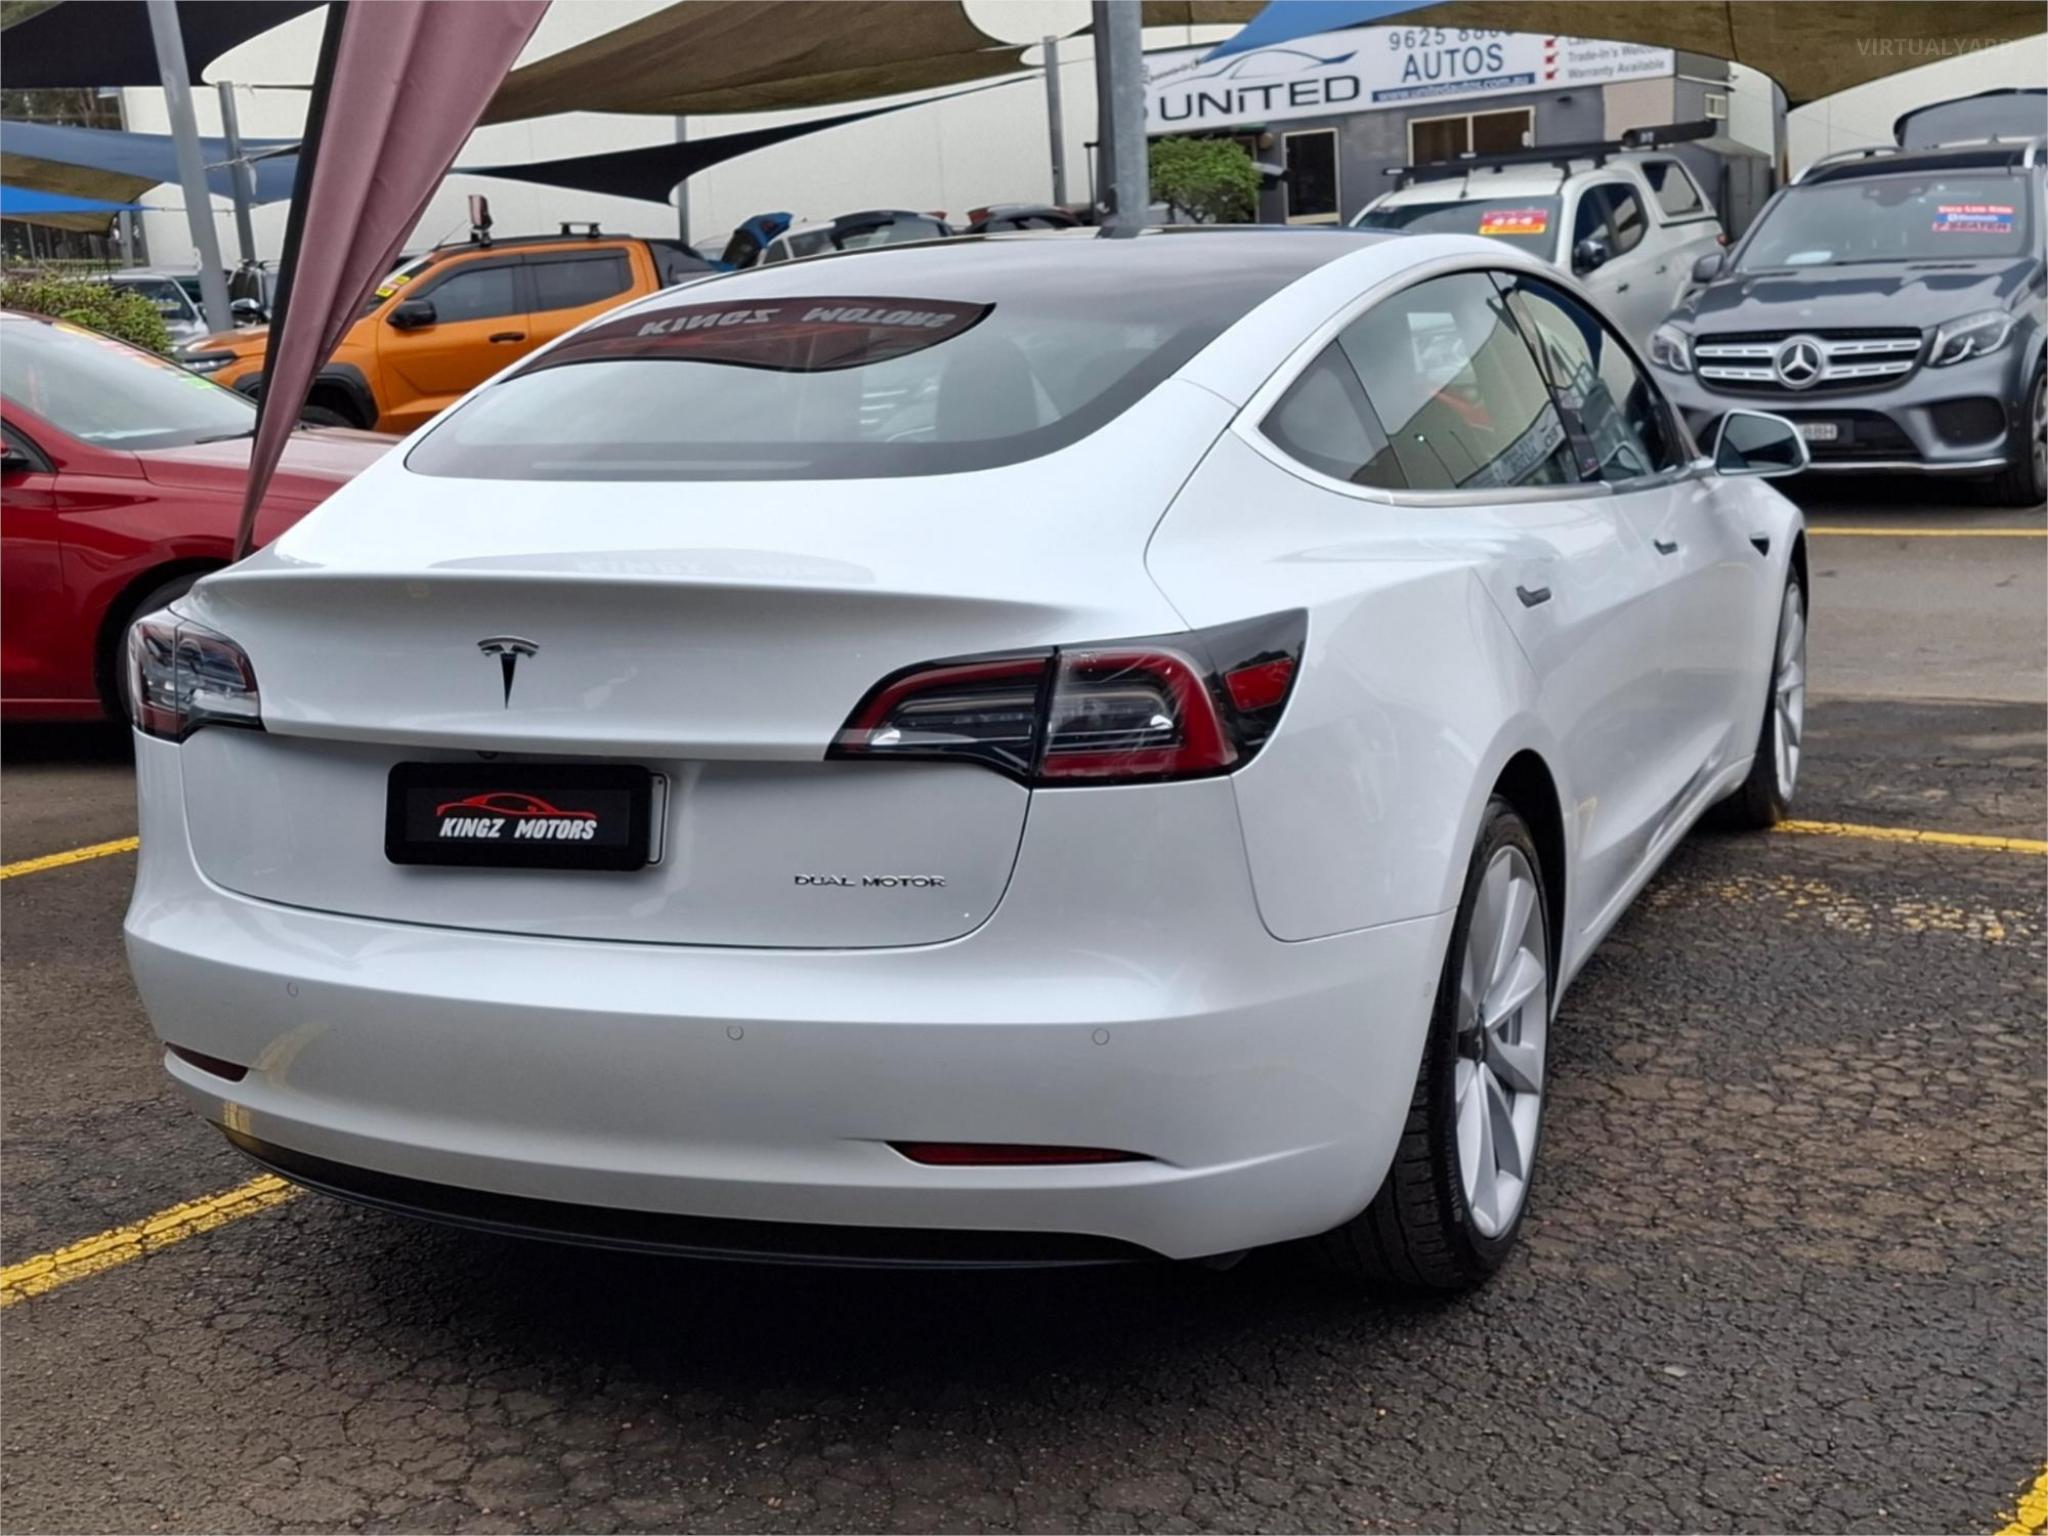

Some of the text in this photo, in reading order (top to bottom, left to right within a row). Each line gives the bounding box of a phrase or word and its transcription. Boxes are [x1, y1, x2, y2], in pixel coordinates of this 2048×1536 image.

[1389, 28, 1446, 51] 9625
[1402, 43, 1504, 83] AUTOS
[1568, 59, 1666, 79] Warranty Available
[439, 817, 598, 841] KINGZ MOTORS
[795, 873, 948, 888] DUAL MOTOR
